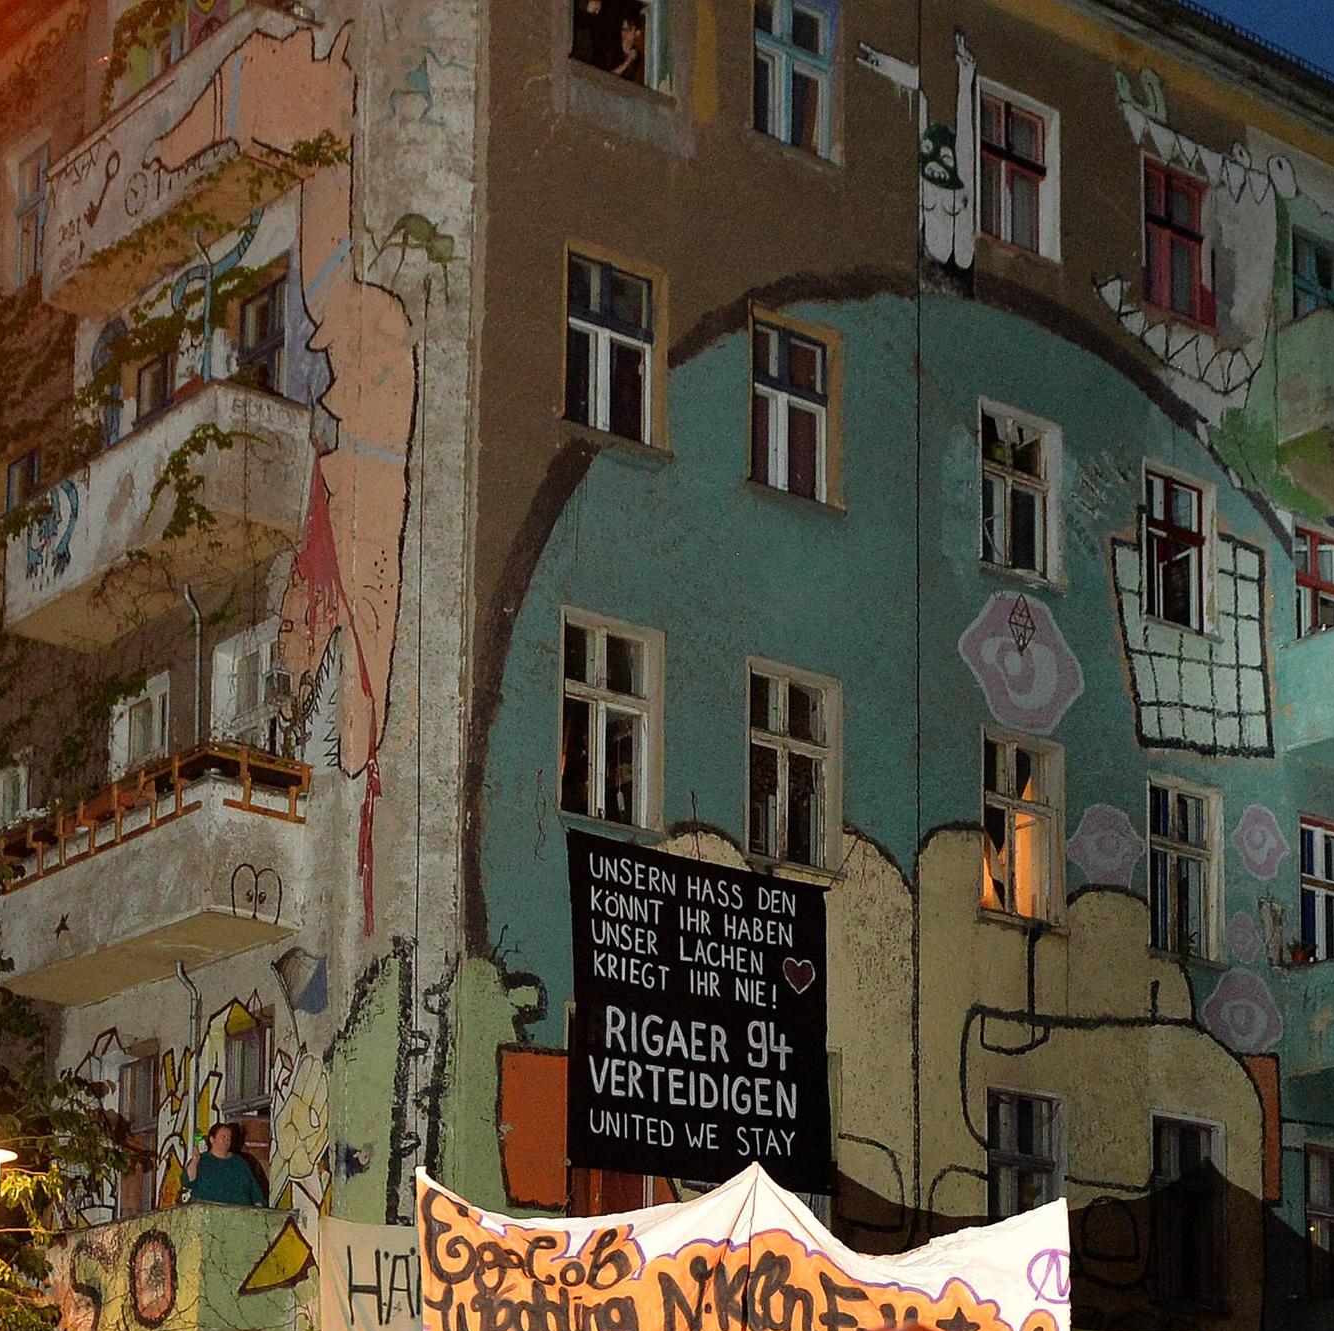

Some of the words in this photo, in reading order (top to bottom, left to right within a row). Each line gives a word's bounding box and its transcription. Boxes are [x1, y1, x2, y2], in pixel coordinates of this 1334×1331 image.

[589, 852, 676, 896] UNSERN
[687, 876, 743, 910] HASS
[758, 886, 796, 917] DEN
[591, 885, 664, 925] KÖNNT
[679, 906, 711, 935] IHR
[724, 914, 793, 948] HABEN
[591, 918, 658, 955] UNSER
[679, 936, 763, 975] LACHEN
[593, 949, 670, 991] KRIEGT
[690, 968, 721, 997] IHR
[735, 977, 777, 1010] NIE!
[605, 1005, 730, 1063] RIGAER
[747, 1020, 793, 1071] 94
[588, 1055, 796, 1119] VERTEIDIGEN
[589, 1108, 674, 1147] UNITED
[685, 1122, 719, 1149] WE
[736, 1127, 795, 1156] STAY
[347, 1245, 422, 1325] HÄ
